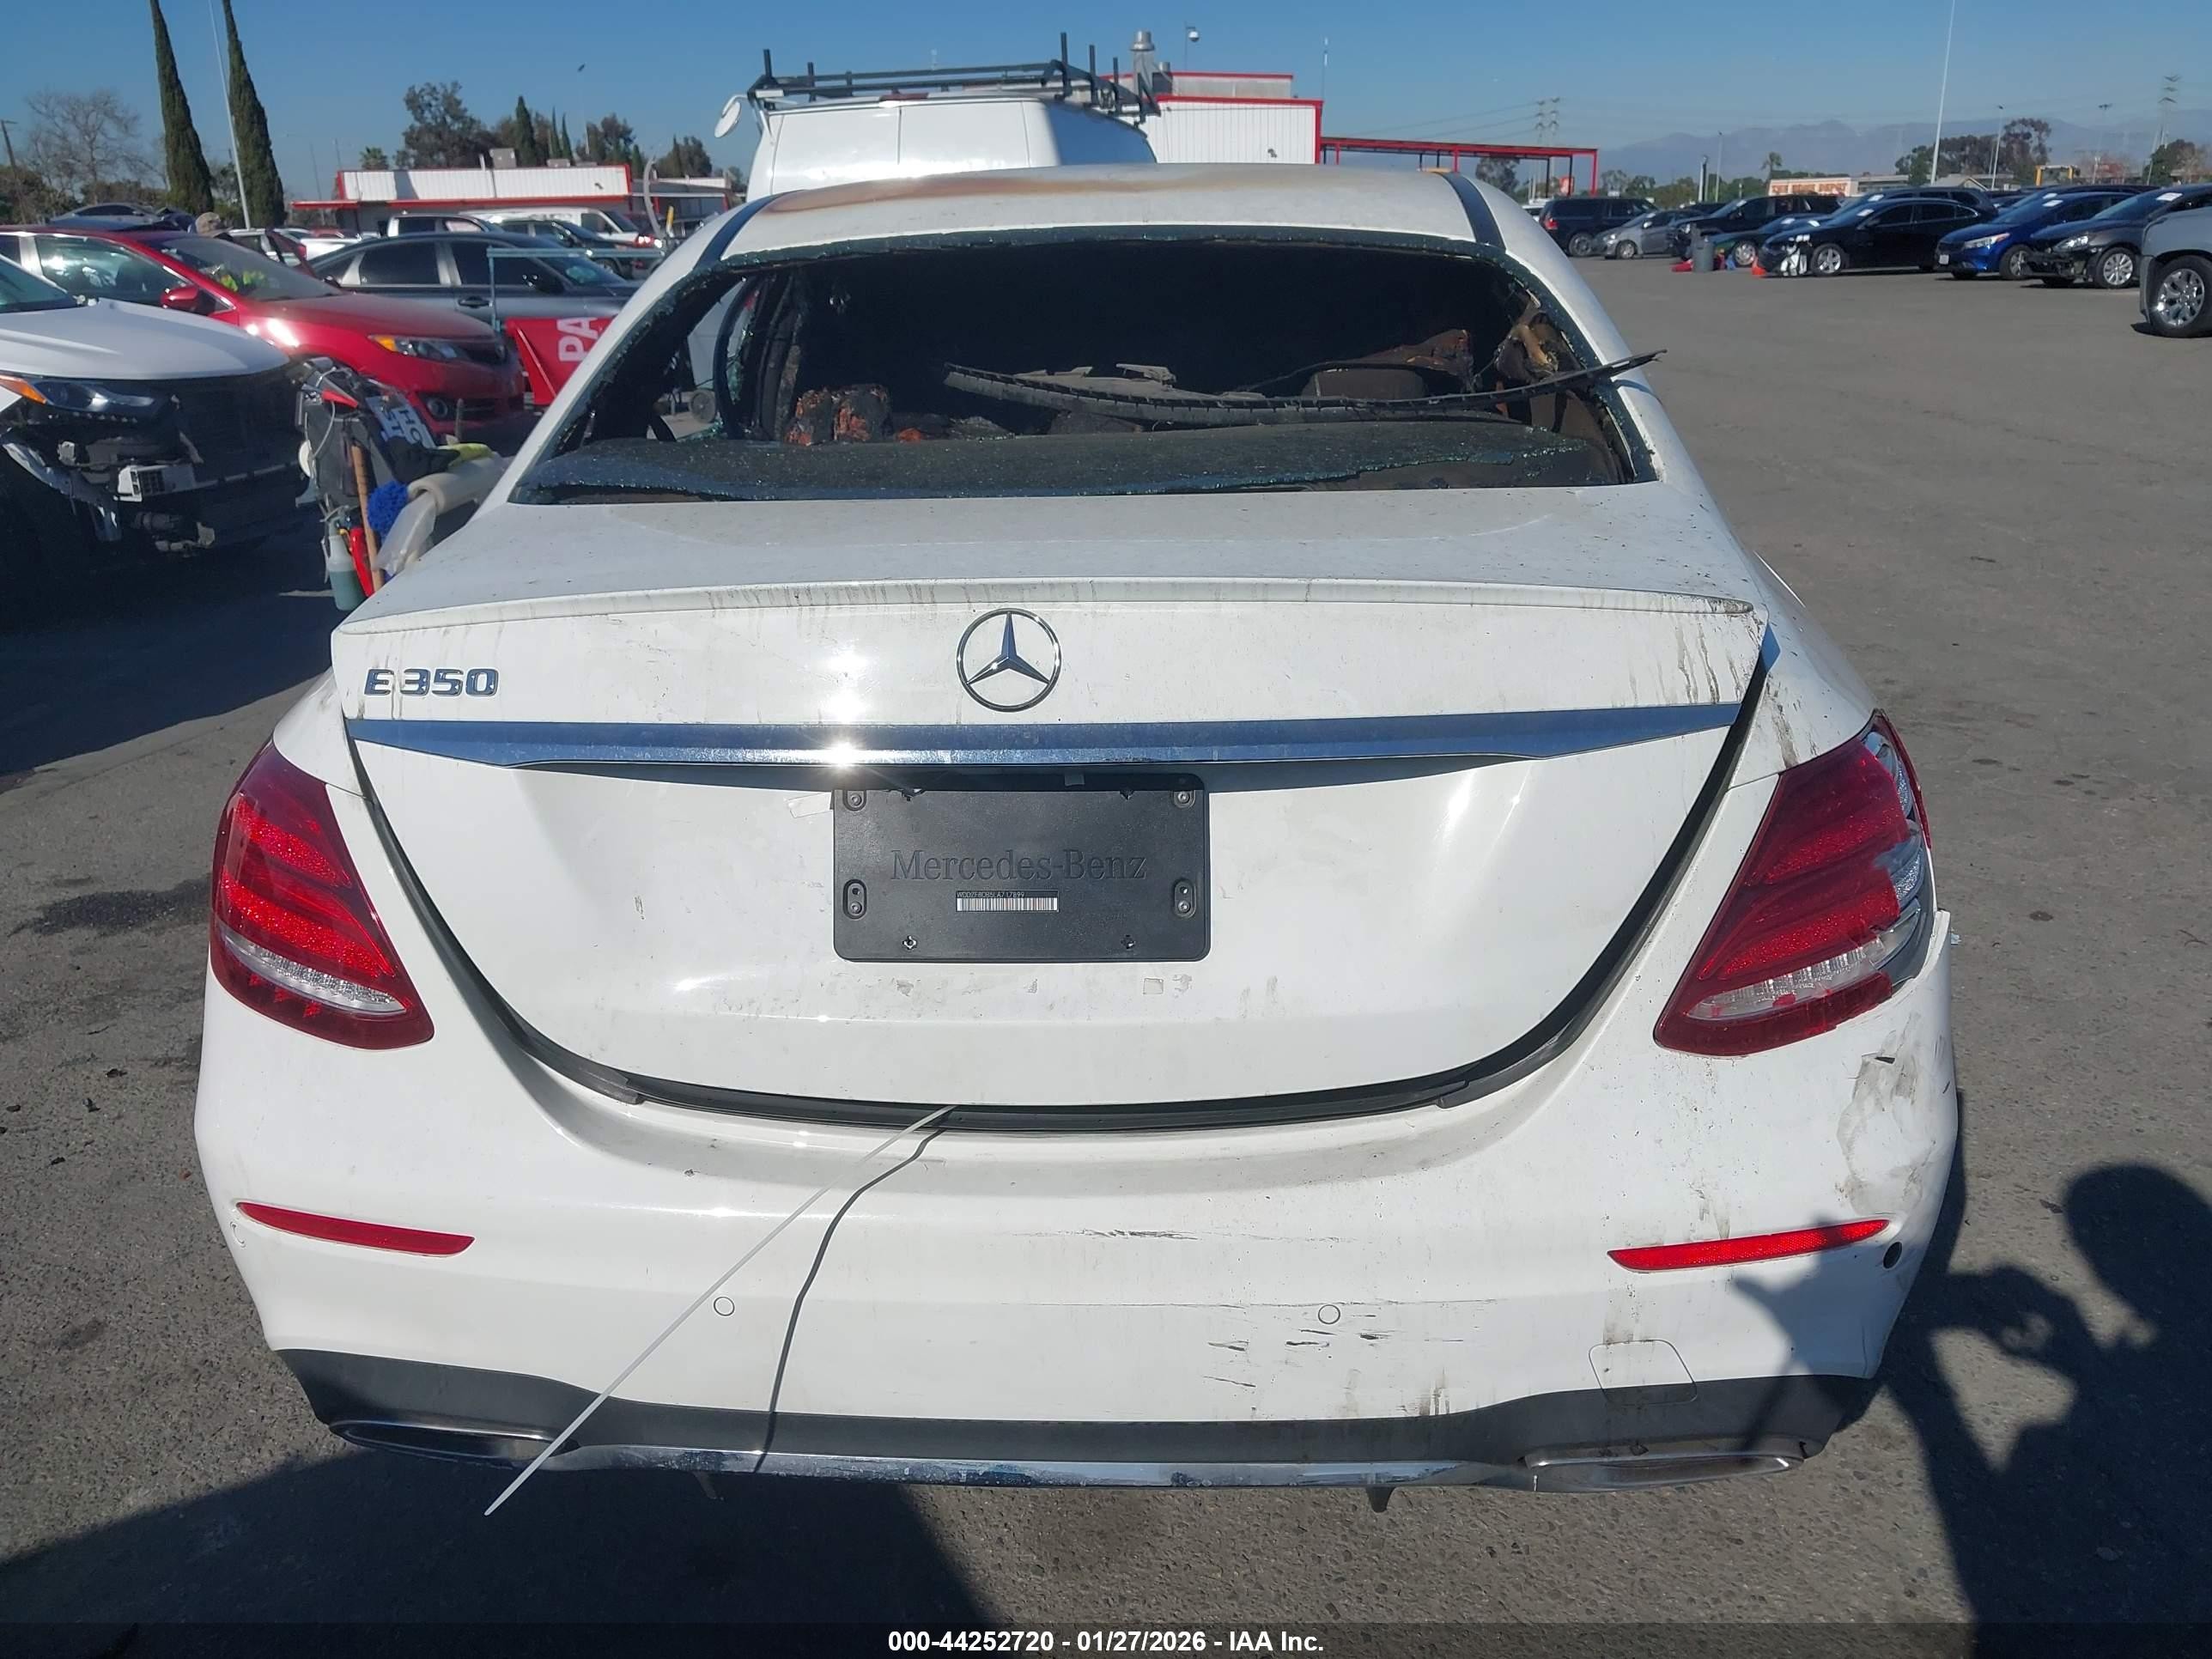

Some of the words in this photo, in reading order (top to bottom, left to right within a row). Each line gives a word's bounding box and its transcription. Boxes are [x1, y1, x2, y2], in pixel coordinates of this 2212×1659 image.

[364, 668, 395, 696] E
[400, 668, 500, 697] 350
[890, 848, 1147, 881] Mercedes-Benz
